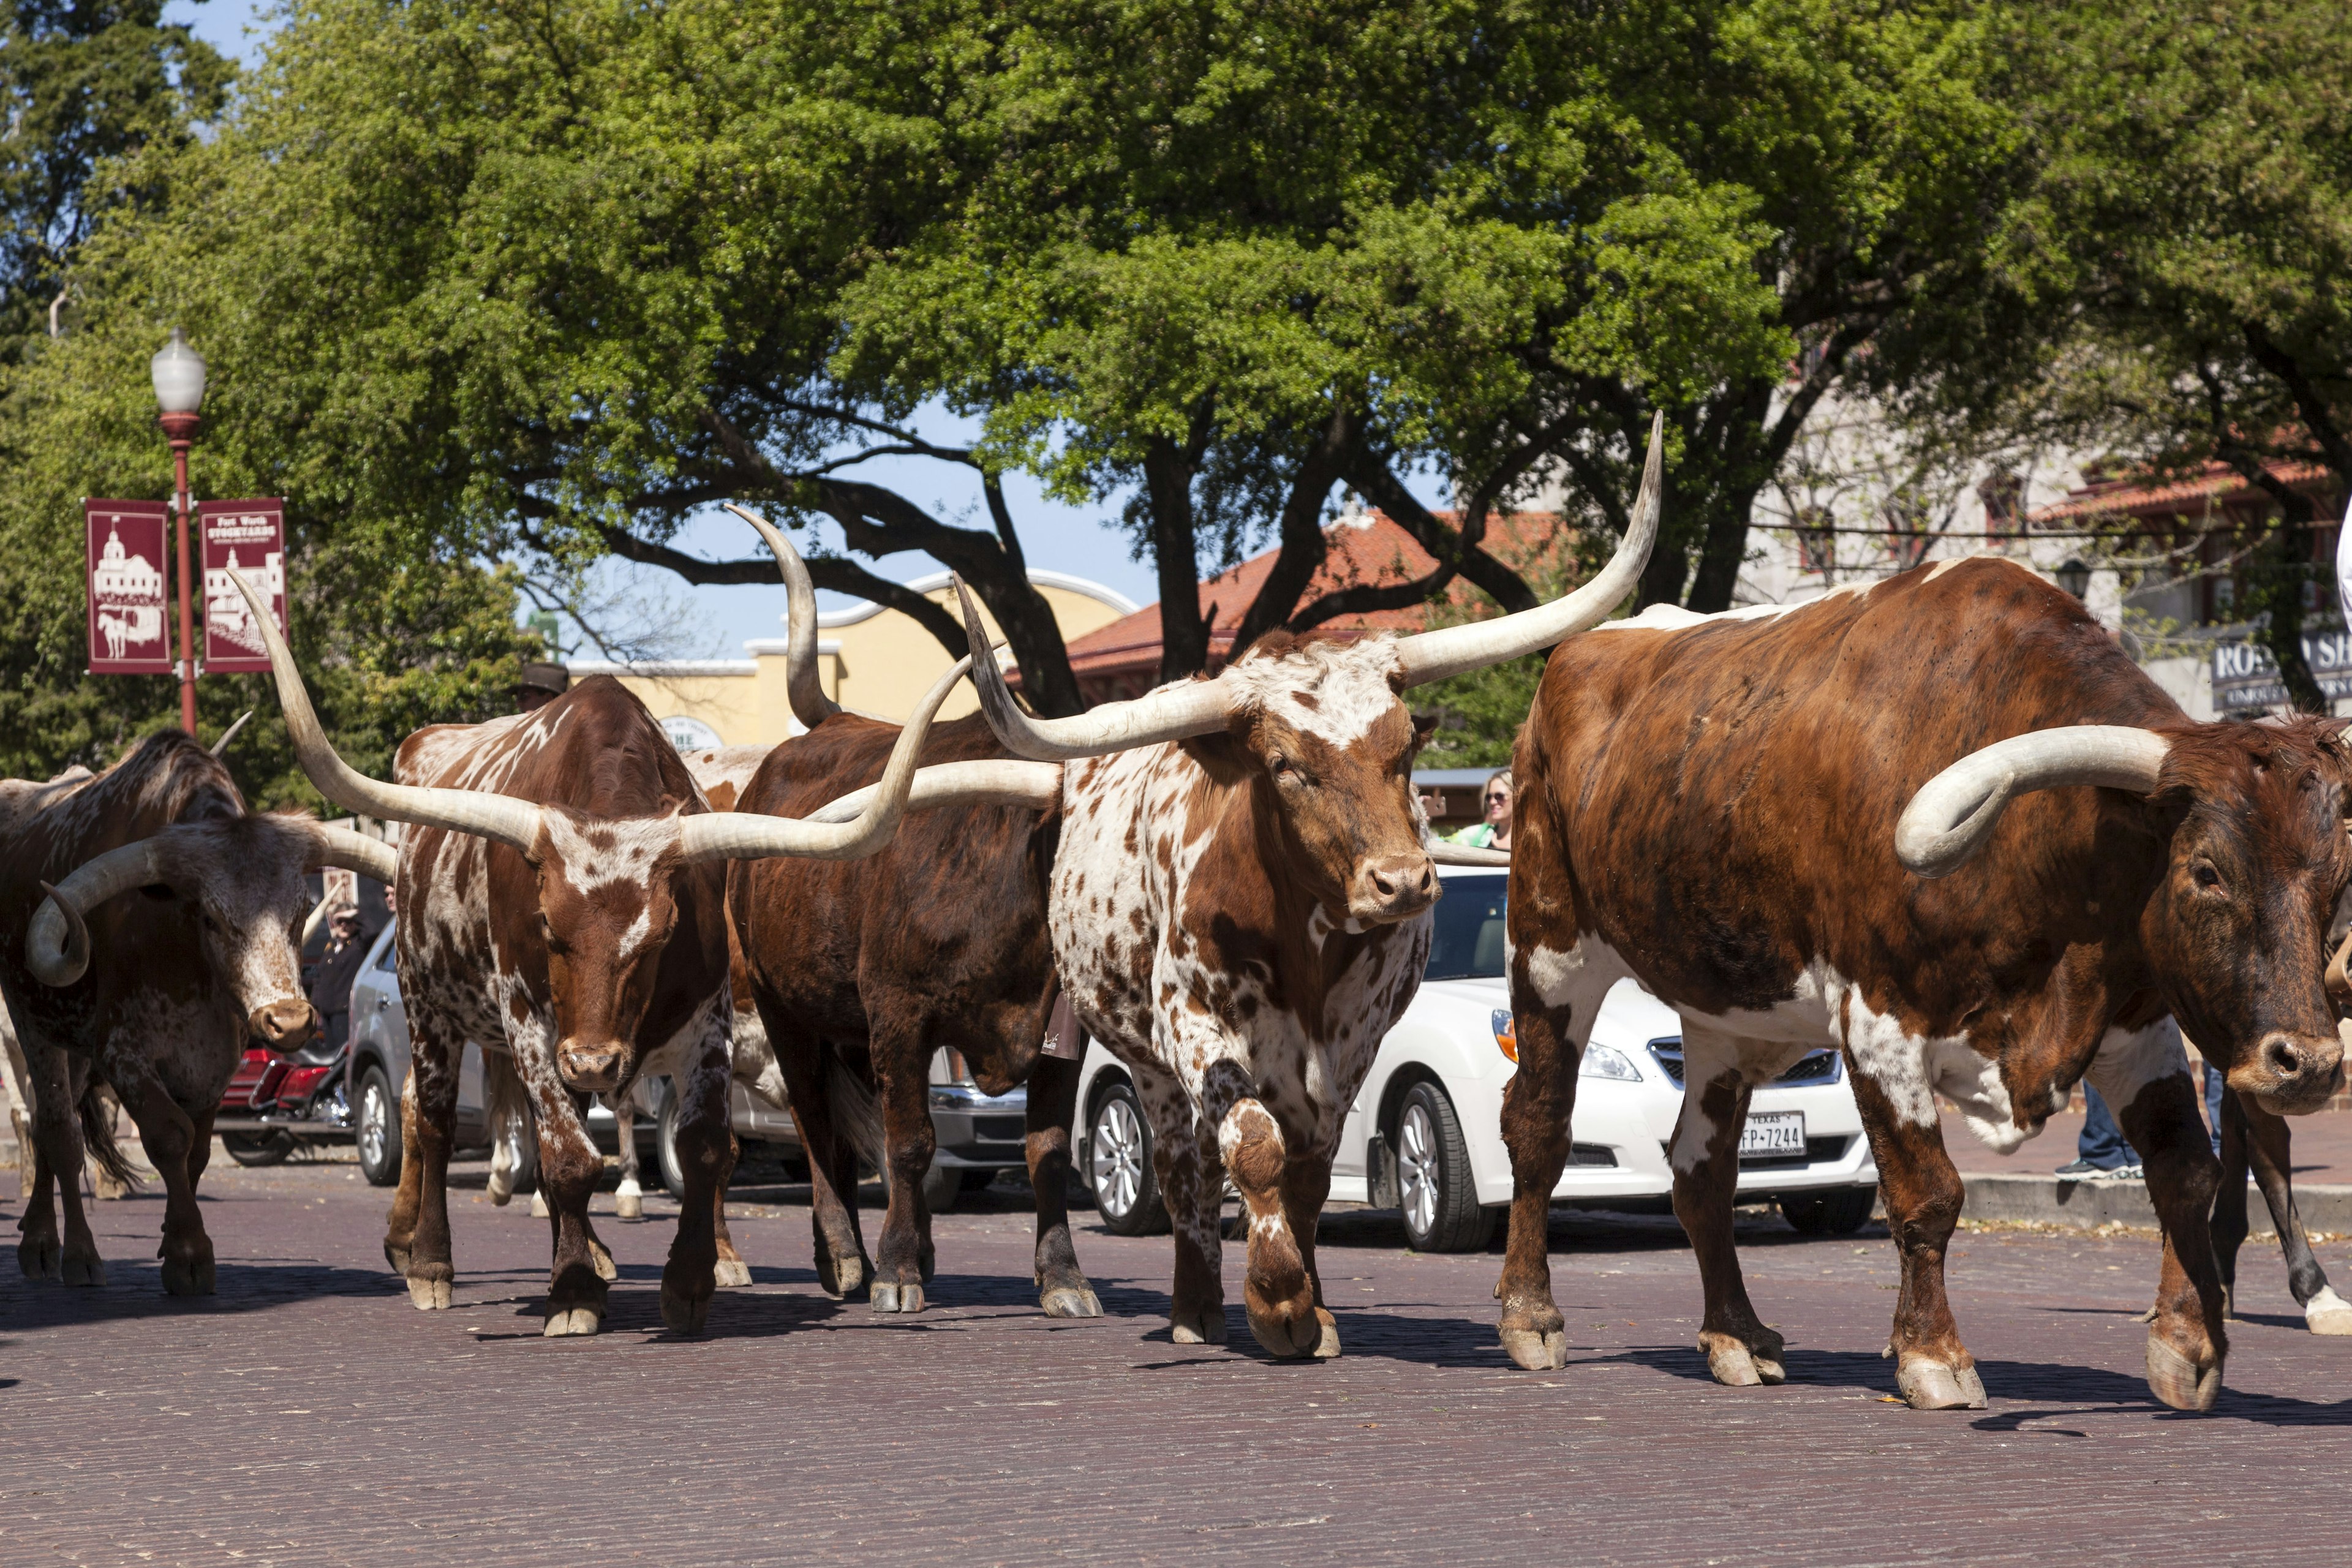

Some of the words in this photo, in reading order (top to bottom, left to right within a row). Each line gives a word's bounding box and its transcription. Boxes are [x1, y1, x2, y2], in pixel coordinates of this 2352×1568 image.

[239, 515, 268, 526] Worth
[208, 525, 276, 539] STOCKYARDS
[1753, 1115, 1781, 1124] TEXAS
[1741, 1129, 1758, 1148] FP
